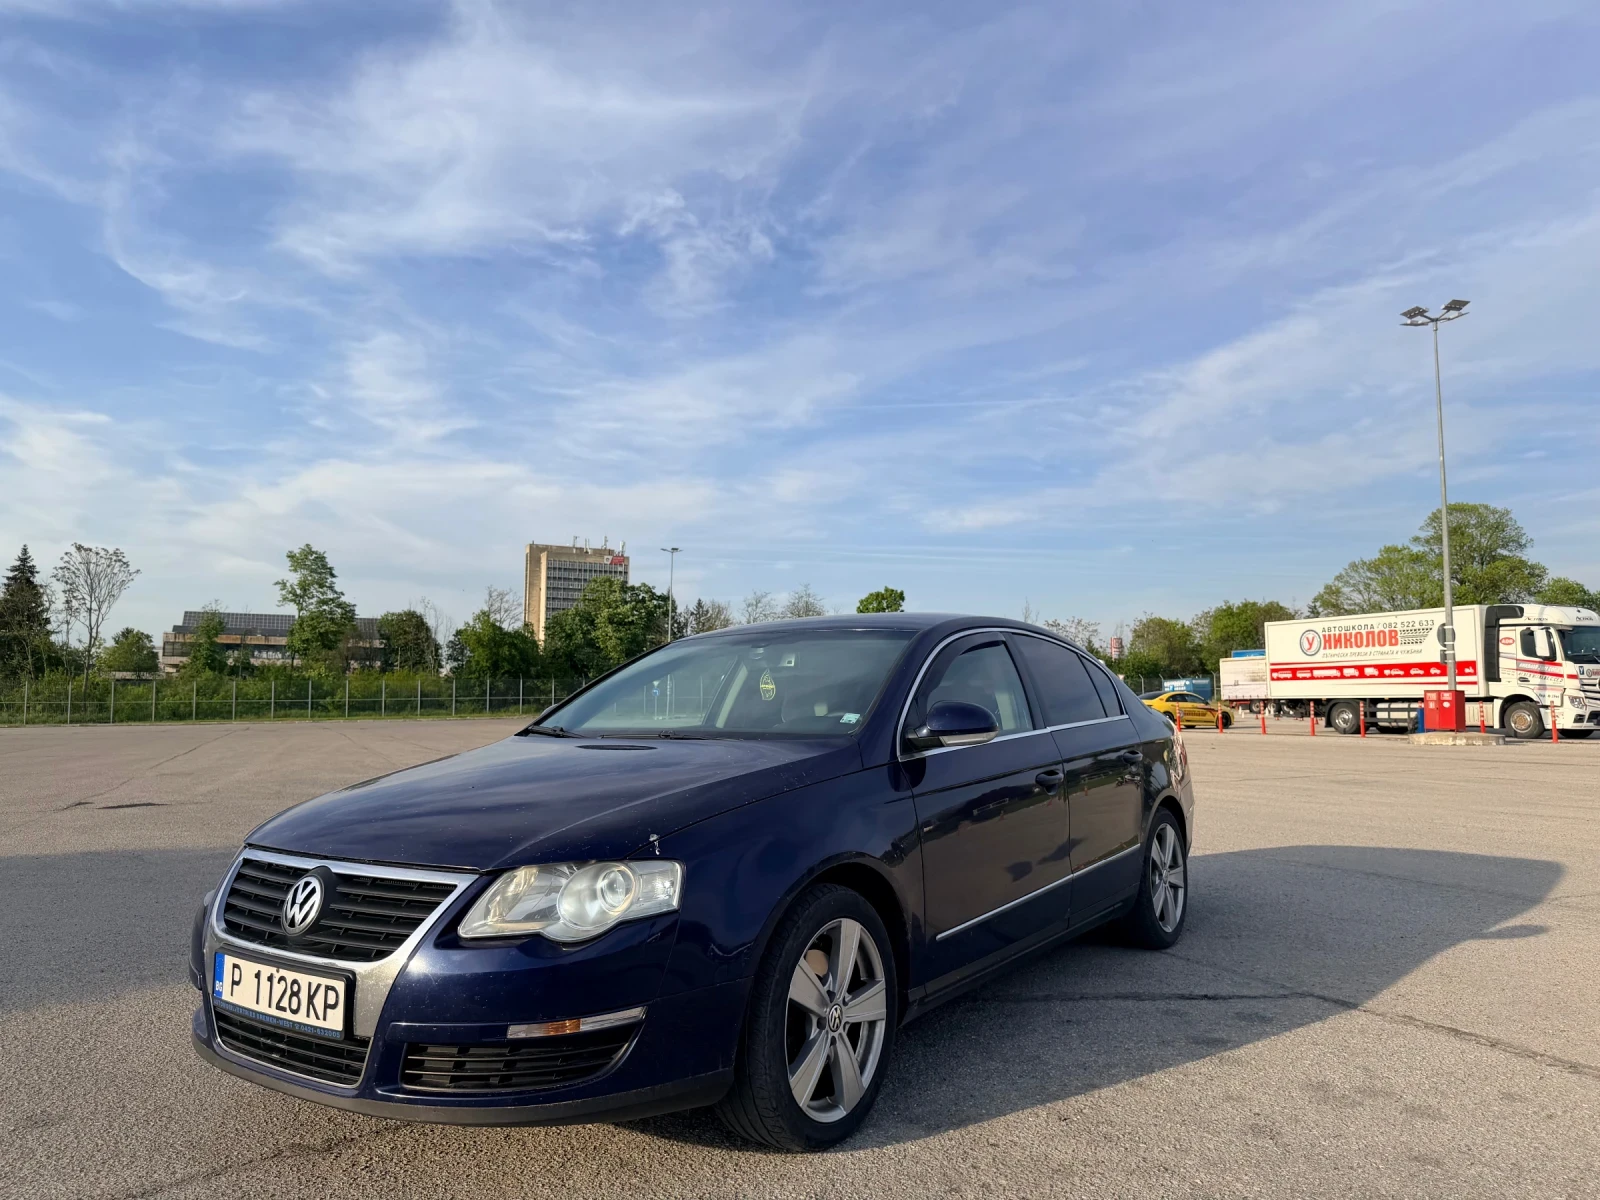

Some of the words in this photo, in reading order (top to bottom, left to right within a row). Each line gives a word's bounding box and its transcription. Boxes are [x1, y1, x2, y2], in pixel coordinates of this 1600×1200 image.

[1321, 624, 1375, 633] АВТОШКОЛА
[1418, 619, 1435, 627] 633
[1322, 629, 1399, 650] НИКОЛОВ
[284, 876, 321, 934] VW
[215, 980, 223, 991] BG
[230, 963, 242, 997] P
[256, 1012, 293, 1028] BREMEN-WEST
